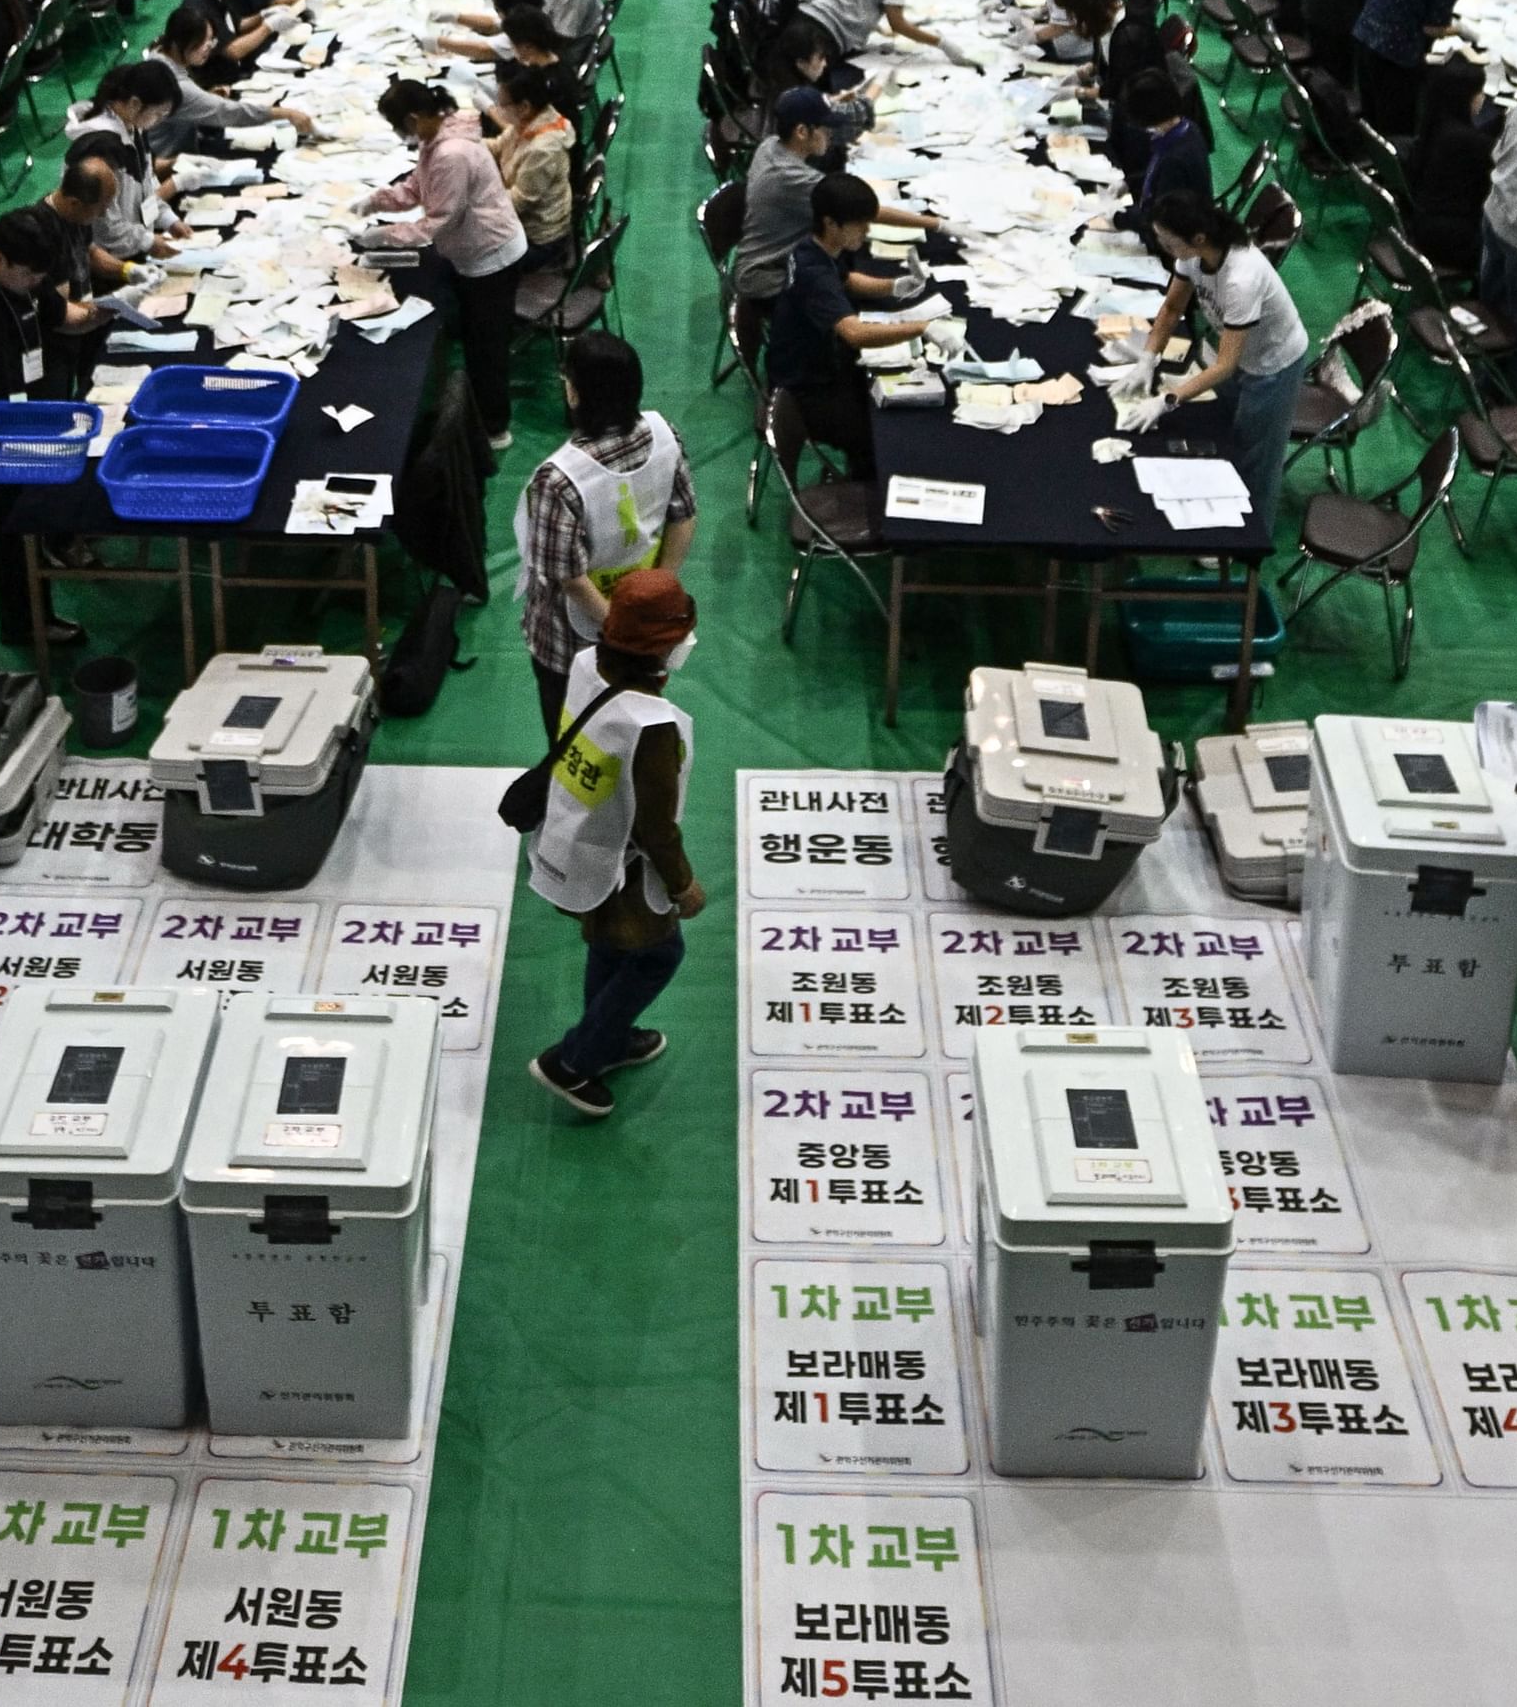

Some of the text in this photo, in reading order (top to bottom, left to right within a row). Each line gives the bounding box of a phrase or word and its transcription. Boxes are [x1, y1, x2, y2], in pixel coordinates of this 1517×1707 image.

[759, 789, 890, 814] 관내사전
[760, 832, 893, 866] 행운동
[49, 912, 124, 940] 교부
[160, 915, 302, 943] 2차 교부
[341, 920, 481, 948] 2차 교부
[760, 926, 900, 954] 2차 교부
[940, 929, 1082, 957] 2차 교부
[1121, 930, 1265, 961] 2차 교부
[176, 959, 265, 982] 서원동
[361, 964, 449, 988] 서원동
[1387, 954, 1481, 979] 투표함
[791, 972, 878, 995] 조원동
[977, 974, 1064, 997] 조원동
[1162, 976, 1251, 1000] 조원동
[766, 1000, 907, 1026] 제1투표소
[955, 1003, 1097, 1027] 제2투표소
[1143, 1005, 1287, 1030] 제3투표소
[763, 1089, 916, 1122] 2차 교부
[1239, 1095, 1316, 1128] 교부
[797, 1142, 891, 1169] 중앙동
[769, 1177, 924, 1205] 제1투표소
[1228, 1185, 1342, 1215] 3투표소
[247, 1300, 356, 1325] 투표함
[770, 1284, 935, 1324] 1차 교부
[1288, 1294, 1376, 1332] 교부
[1426, 1294, 1502, 1333] 1차
[786, 1349, 927, 1380] 보라매동
[1236, 1356, 1380, 1391] 보라매동
[773, 1390, 946, 1426] 제1투표소
[1232, 1399, 1410, 1437] 제3투표소
[51, 1502, 150, 1549] 교부
[212, 1507, 390, 1559] 1차 교부
[776, 1522, 960, 1572] 1차 교부
[223, 1586, 343, 1630] 서원동
[794, 1602, 951, 1646] 보라매동
[176, 1640, 369, 1686] 제4투표소
[780, 1655, 973, 1701] 제5투표소
